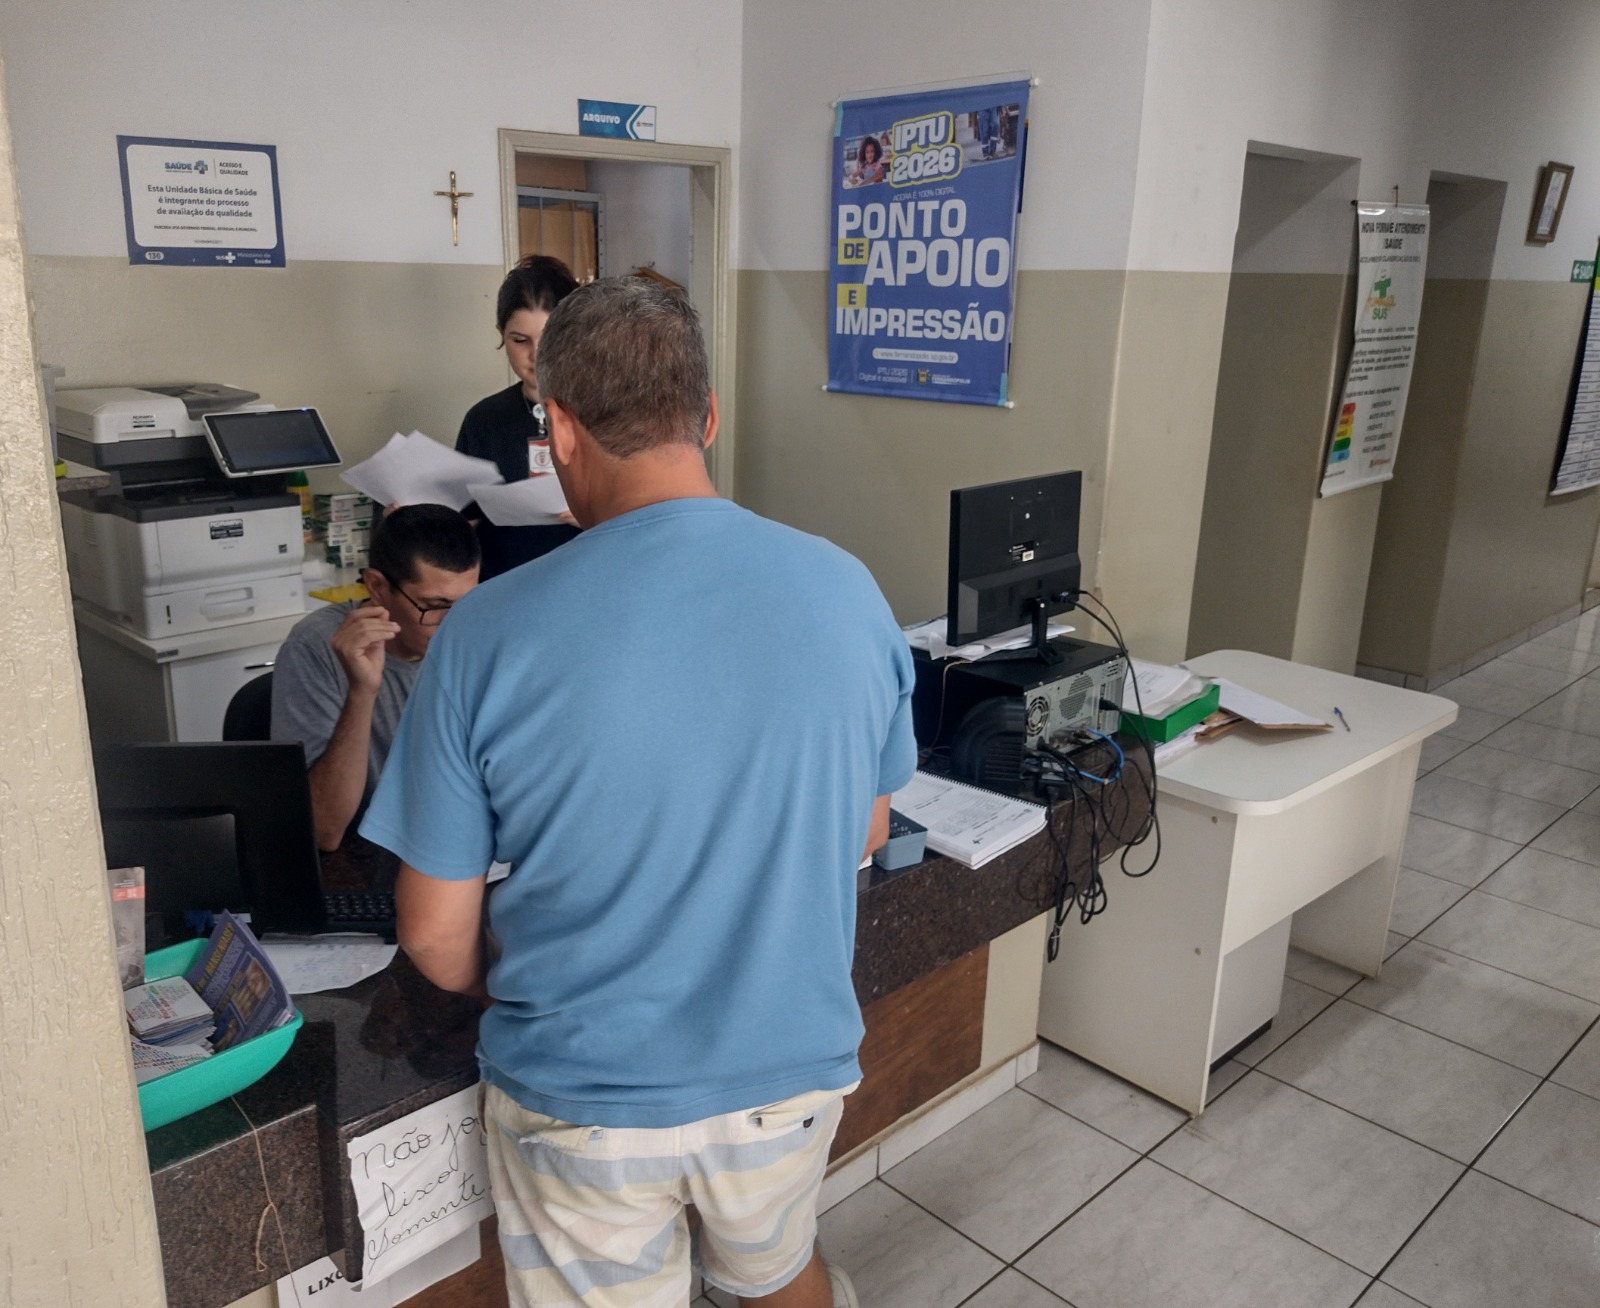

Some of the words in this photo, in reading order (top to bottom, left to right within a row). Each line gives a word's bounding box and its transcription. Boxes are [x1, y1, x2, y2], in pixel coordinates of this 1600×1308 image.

[583, 113, 620, 124] ARQUIVO
[894, 116, 946, 151] IPTU
[165, 161, 192, 170] SAÚDE
[893, 147, 955, 182] 2026
[148, 184, 164, 192] Esta
[166, 184, 198, 194] Unidade
[199, 186, 222, 195] Básica
[224, 187, 234, 196] de
[235, 187, 257, 196] Saúde
[158, 196, 164, 204] é
[164, 196, 204, 206] integrante
[217, 199, 249, 207] processo
[156, 207, 167, 215] de
[216, 210, 252, 218] qualidade
[838, 199, 967, 239] PONTO
[844, 242, 864, 259] DE
[864, 237, 1010, 288] APOIO
[848, 290, 857, 305] E
[836, 302, 1006, 342] IMPRESSÃO
[355, 1127, 432, 1179] Não
